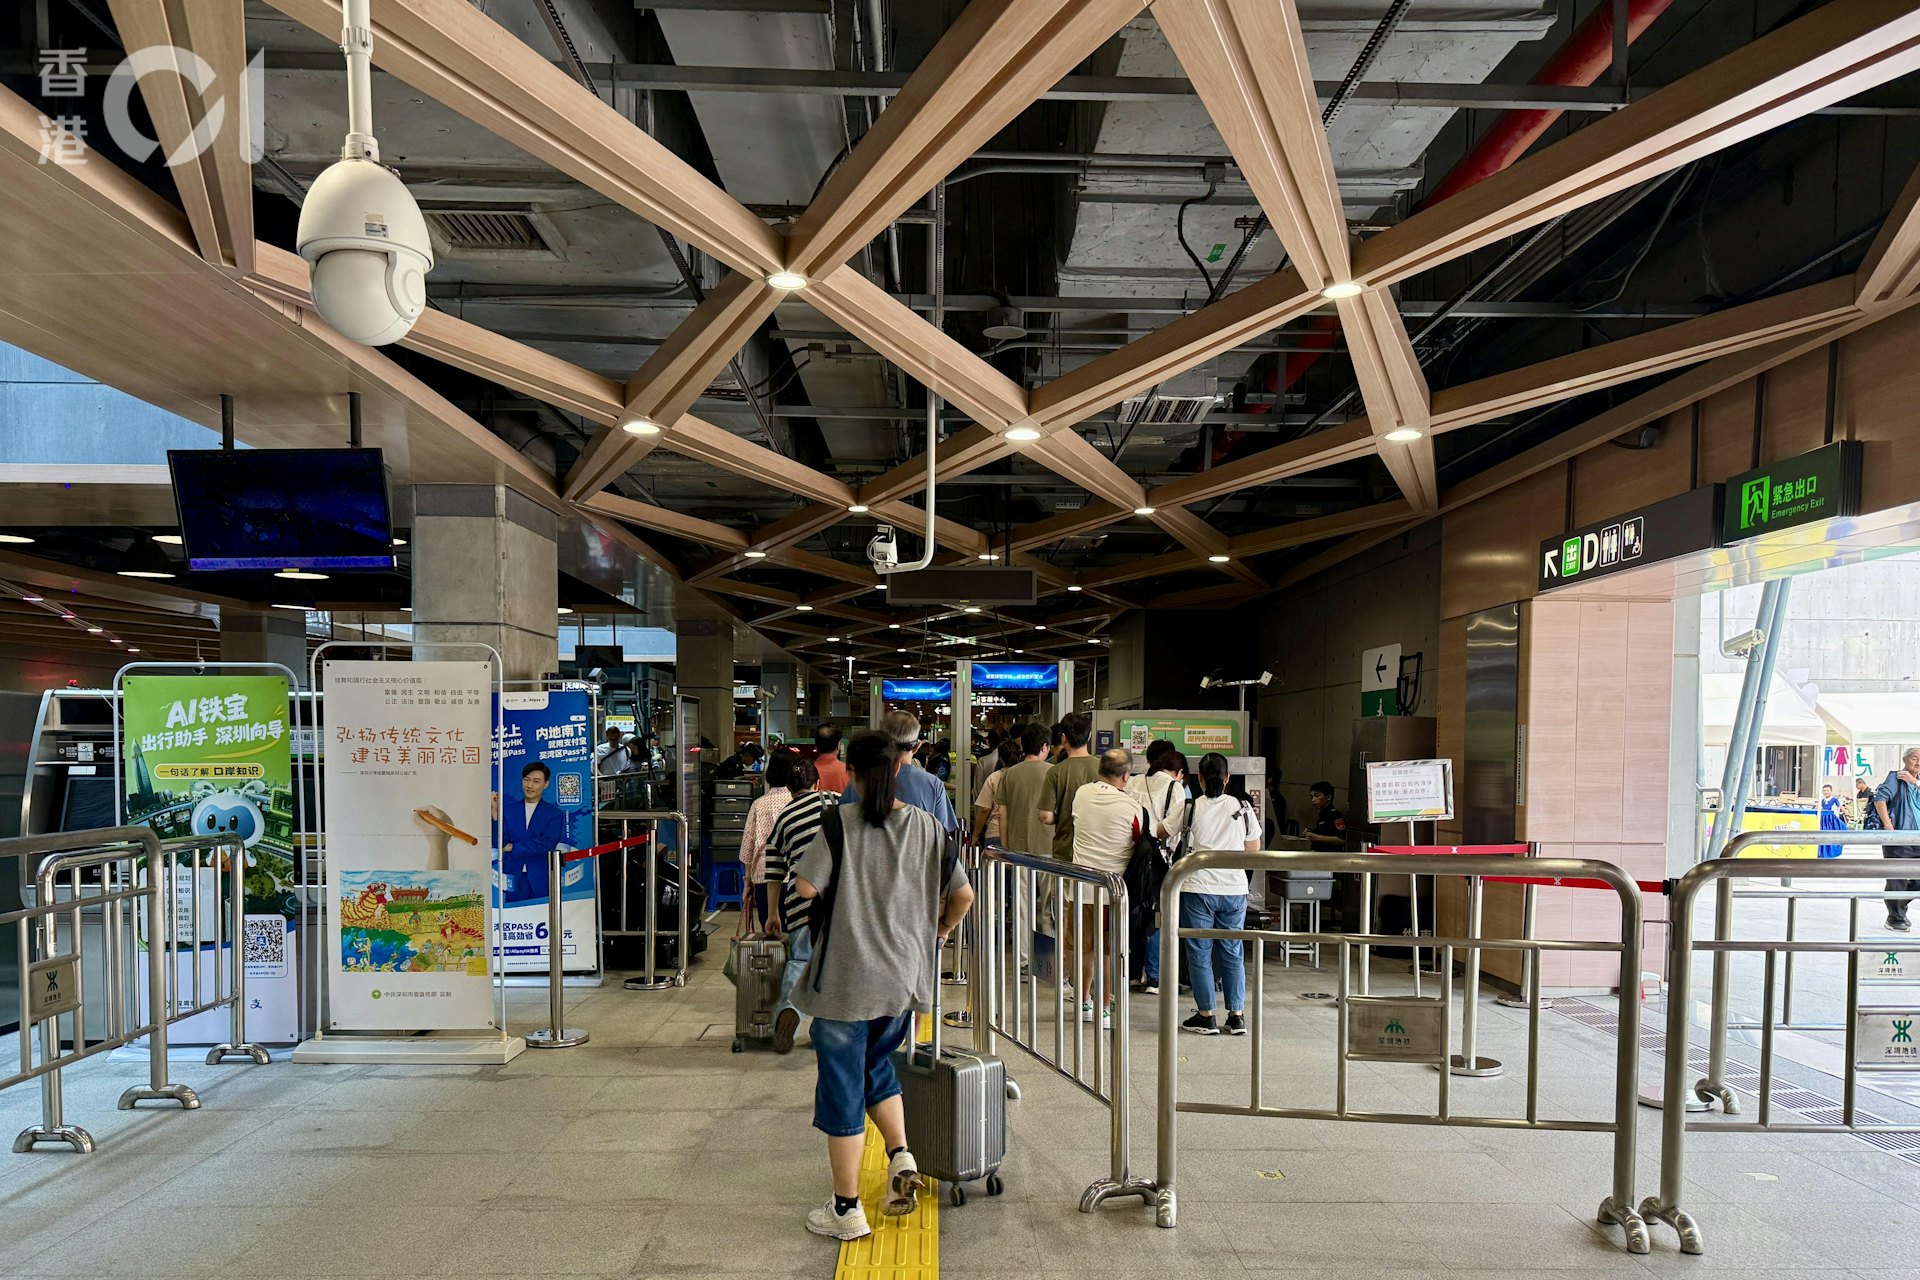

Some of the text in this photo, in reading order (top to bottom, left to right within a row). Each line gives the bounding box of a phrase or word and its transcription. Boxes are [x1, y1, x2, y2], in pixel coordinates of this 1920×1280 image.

[1773, 476, 1817, 505] 紧急出口
[1771, 497, 1825, 519] Emergency Exit
[1566, 544, 1577, 561] 出
[1583, 532, 1599, 571] D
[1565, 561, 1576, 571] EXIT
[165, 693, 248, 729] AI铁宝
[142, 727, 208, 752] 出行助手
[215, 719, 284, 746] 深圳向导
[336, 726, 465, 744] 弘扬传统文化
[536, 723, 586, 741] 内地南下
[491, 738, 523, 749] lipayHK
[548, 737, 587, 749] 就用支付宝
[351, 746, 480, 765] 建设美丽家园
[539, 746, 587, 760] 买湾区Pass卡
[159, 766, 259, 777] 一句话了解 口岸知识
[535, 922, 573, 939] 6 元
[1378, 1037, 1411, 1045] 深圳地铁
[1885, 1047, 1917, 1055] 深圳地铁
